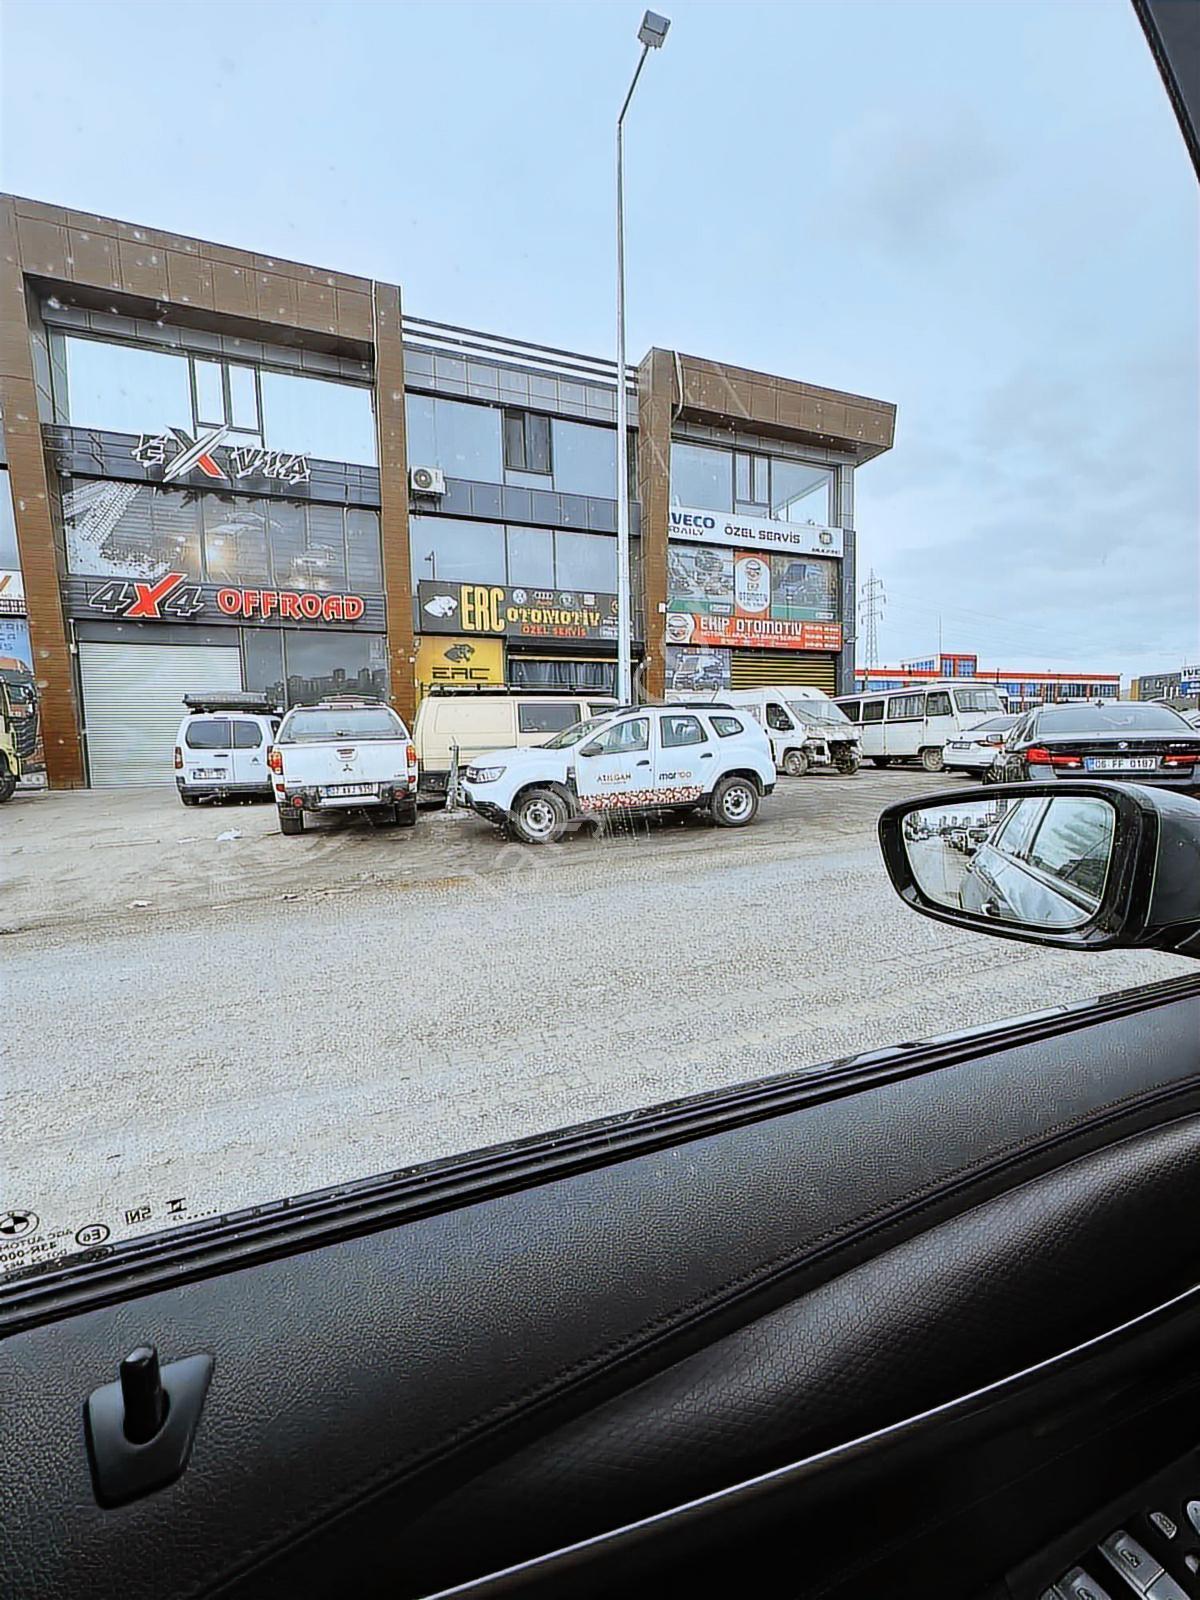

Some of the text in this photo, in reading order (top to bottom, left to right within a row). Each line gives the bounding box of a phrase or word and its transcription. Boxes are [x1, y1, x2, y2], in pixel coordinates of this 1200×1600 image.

[671, 511, 716, 529] VECO
[724, 523, 801, 545] ÖZEL SERVİS
[216, 587, 366, 622] OFFROAD
[461, 585, 506, 632] ERC
[1112, 759, 1124, 768] FF
